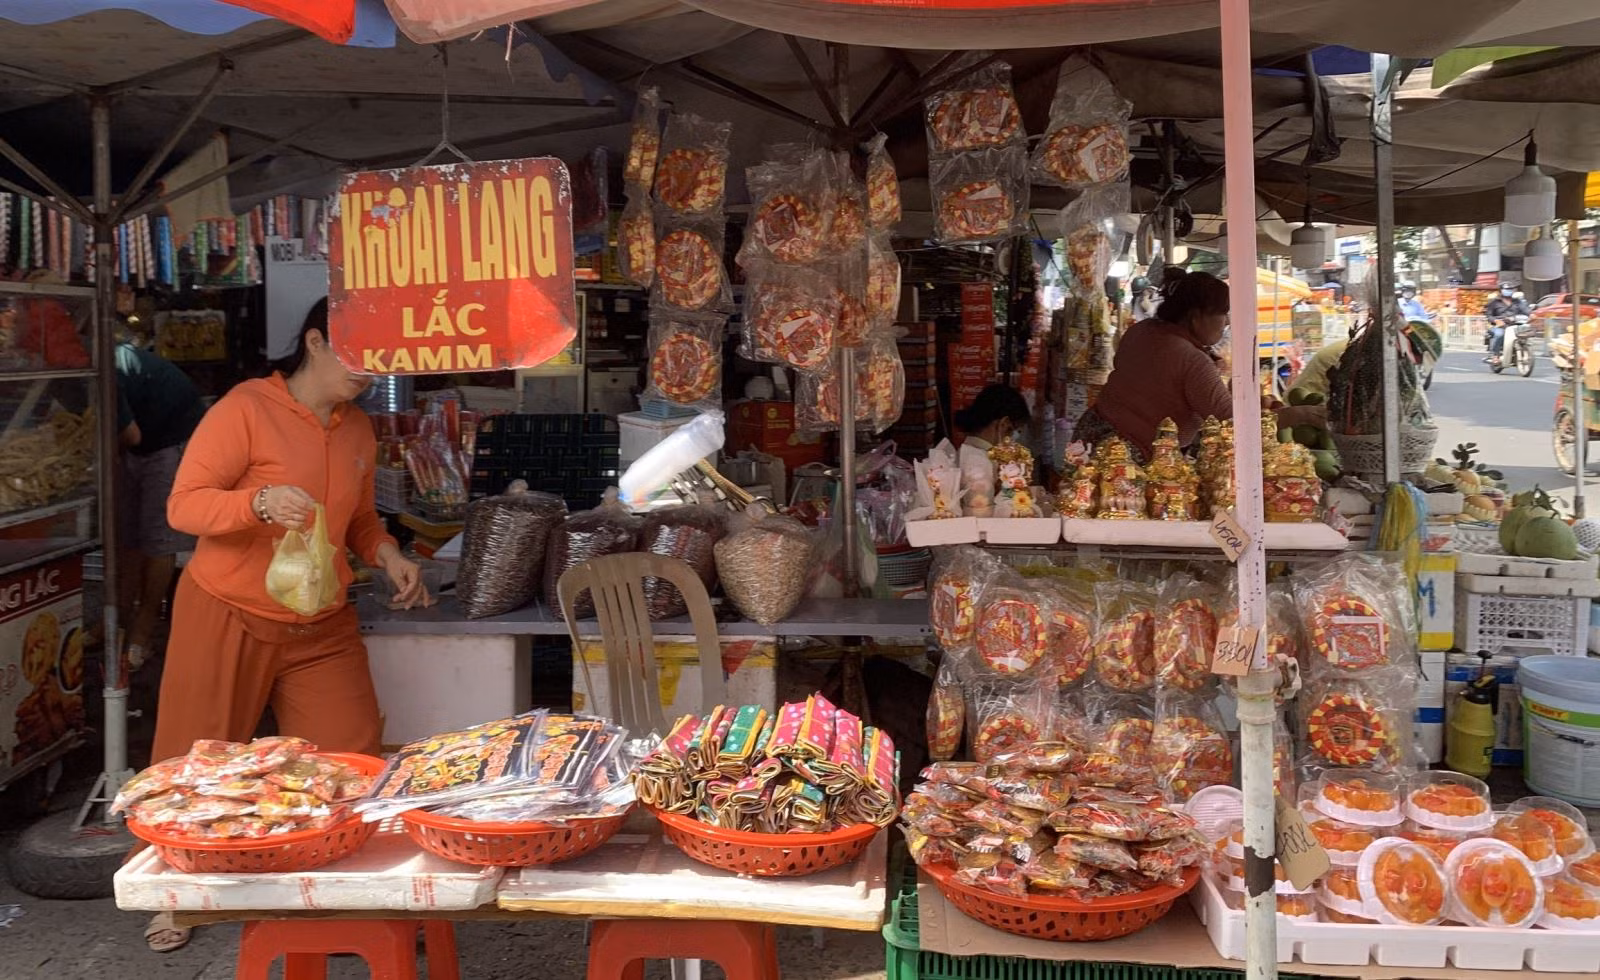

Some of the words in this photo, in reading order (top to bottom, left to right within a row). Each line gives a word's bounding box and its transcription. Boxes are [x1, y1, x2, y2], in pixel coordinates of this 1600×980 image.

[458, 175, 557, 281] LANG
[402, 289, 487, 338] LẮC
[363, 343, 493, 373] KAMM
